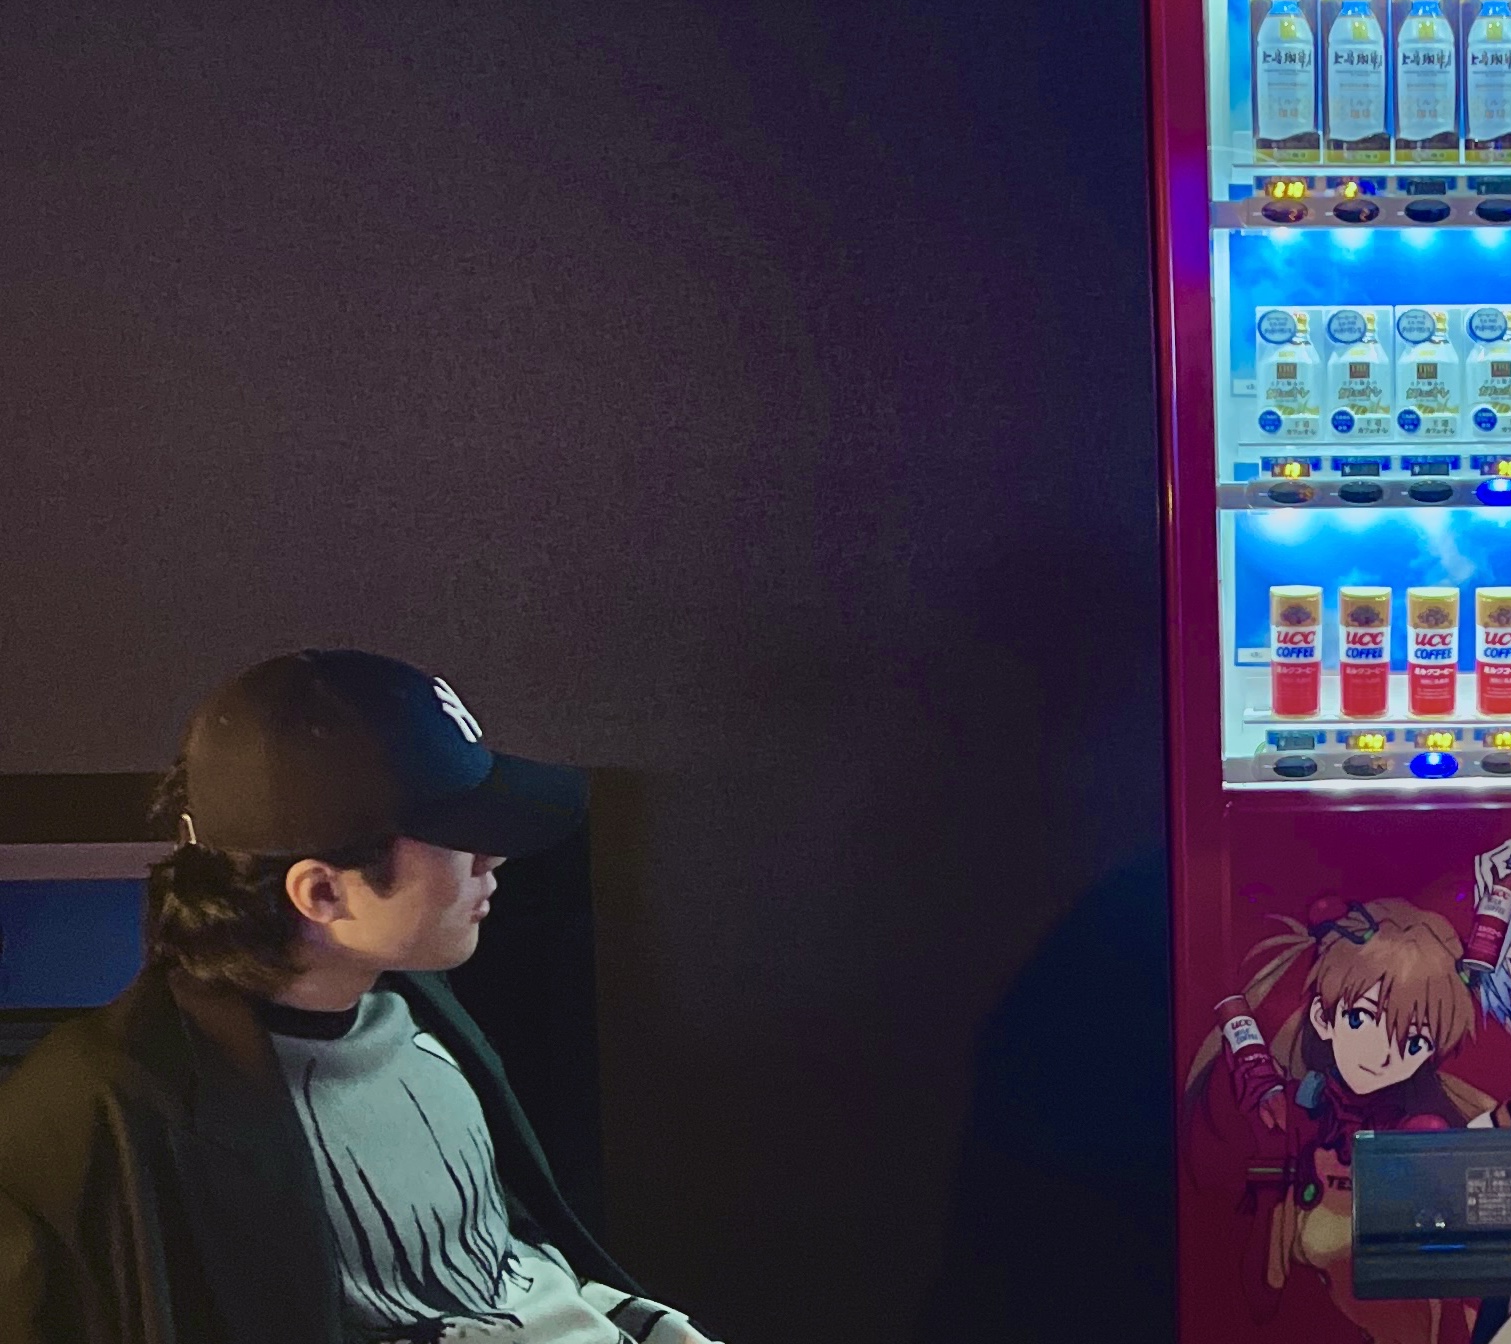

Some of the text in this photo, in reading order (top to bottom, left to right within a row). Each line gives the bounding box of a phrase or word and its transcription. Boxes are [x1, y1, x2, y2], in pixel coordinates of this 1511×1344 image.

[1276, 631, 1316, 645] UCC
[1346, 631, 1384, 646] UCC
[1415, 631, 1453, 646] UCC
[1276, 646, 1315, 658] COFFEE
[1345, 647, 1384, 659] COFFEE
[1414, 647, 1453, 660] COFFEE
